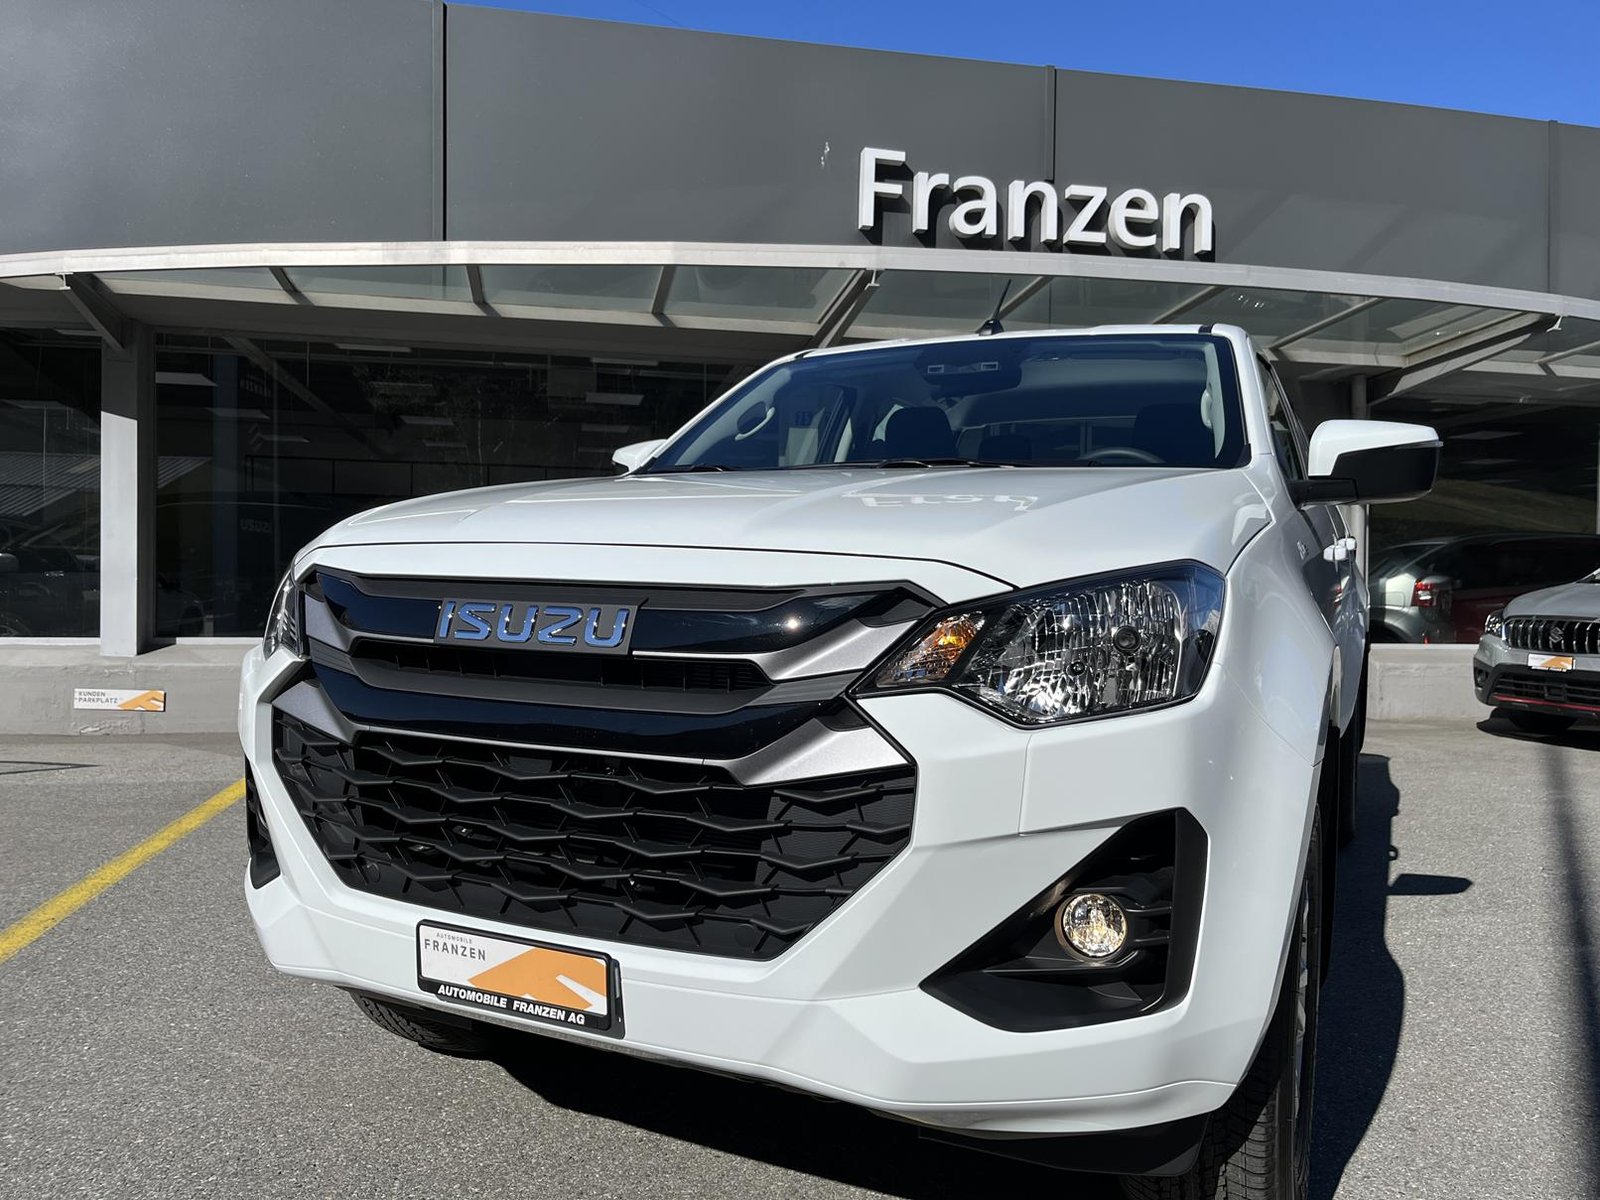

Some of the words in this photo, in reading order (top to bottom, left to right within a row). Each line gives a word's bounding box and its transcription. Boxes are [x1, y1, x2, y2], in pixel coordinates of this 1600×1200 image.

[858, 146, 1213, 255] Franzen
[438, 601, 630, 648] ISUZU
[424, 938, 487, 961] FRANZEN
[436, 931, 473, 944] AUTOMOBILE
[437, 984, 508, 1008] AUTOMOBILE
[512, 1000, 566, 1021] FRANZEN
[567, 1011, 586, 1025] AG
